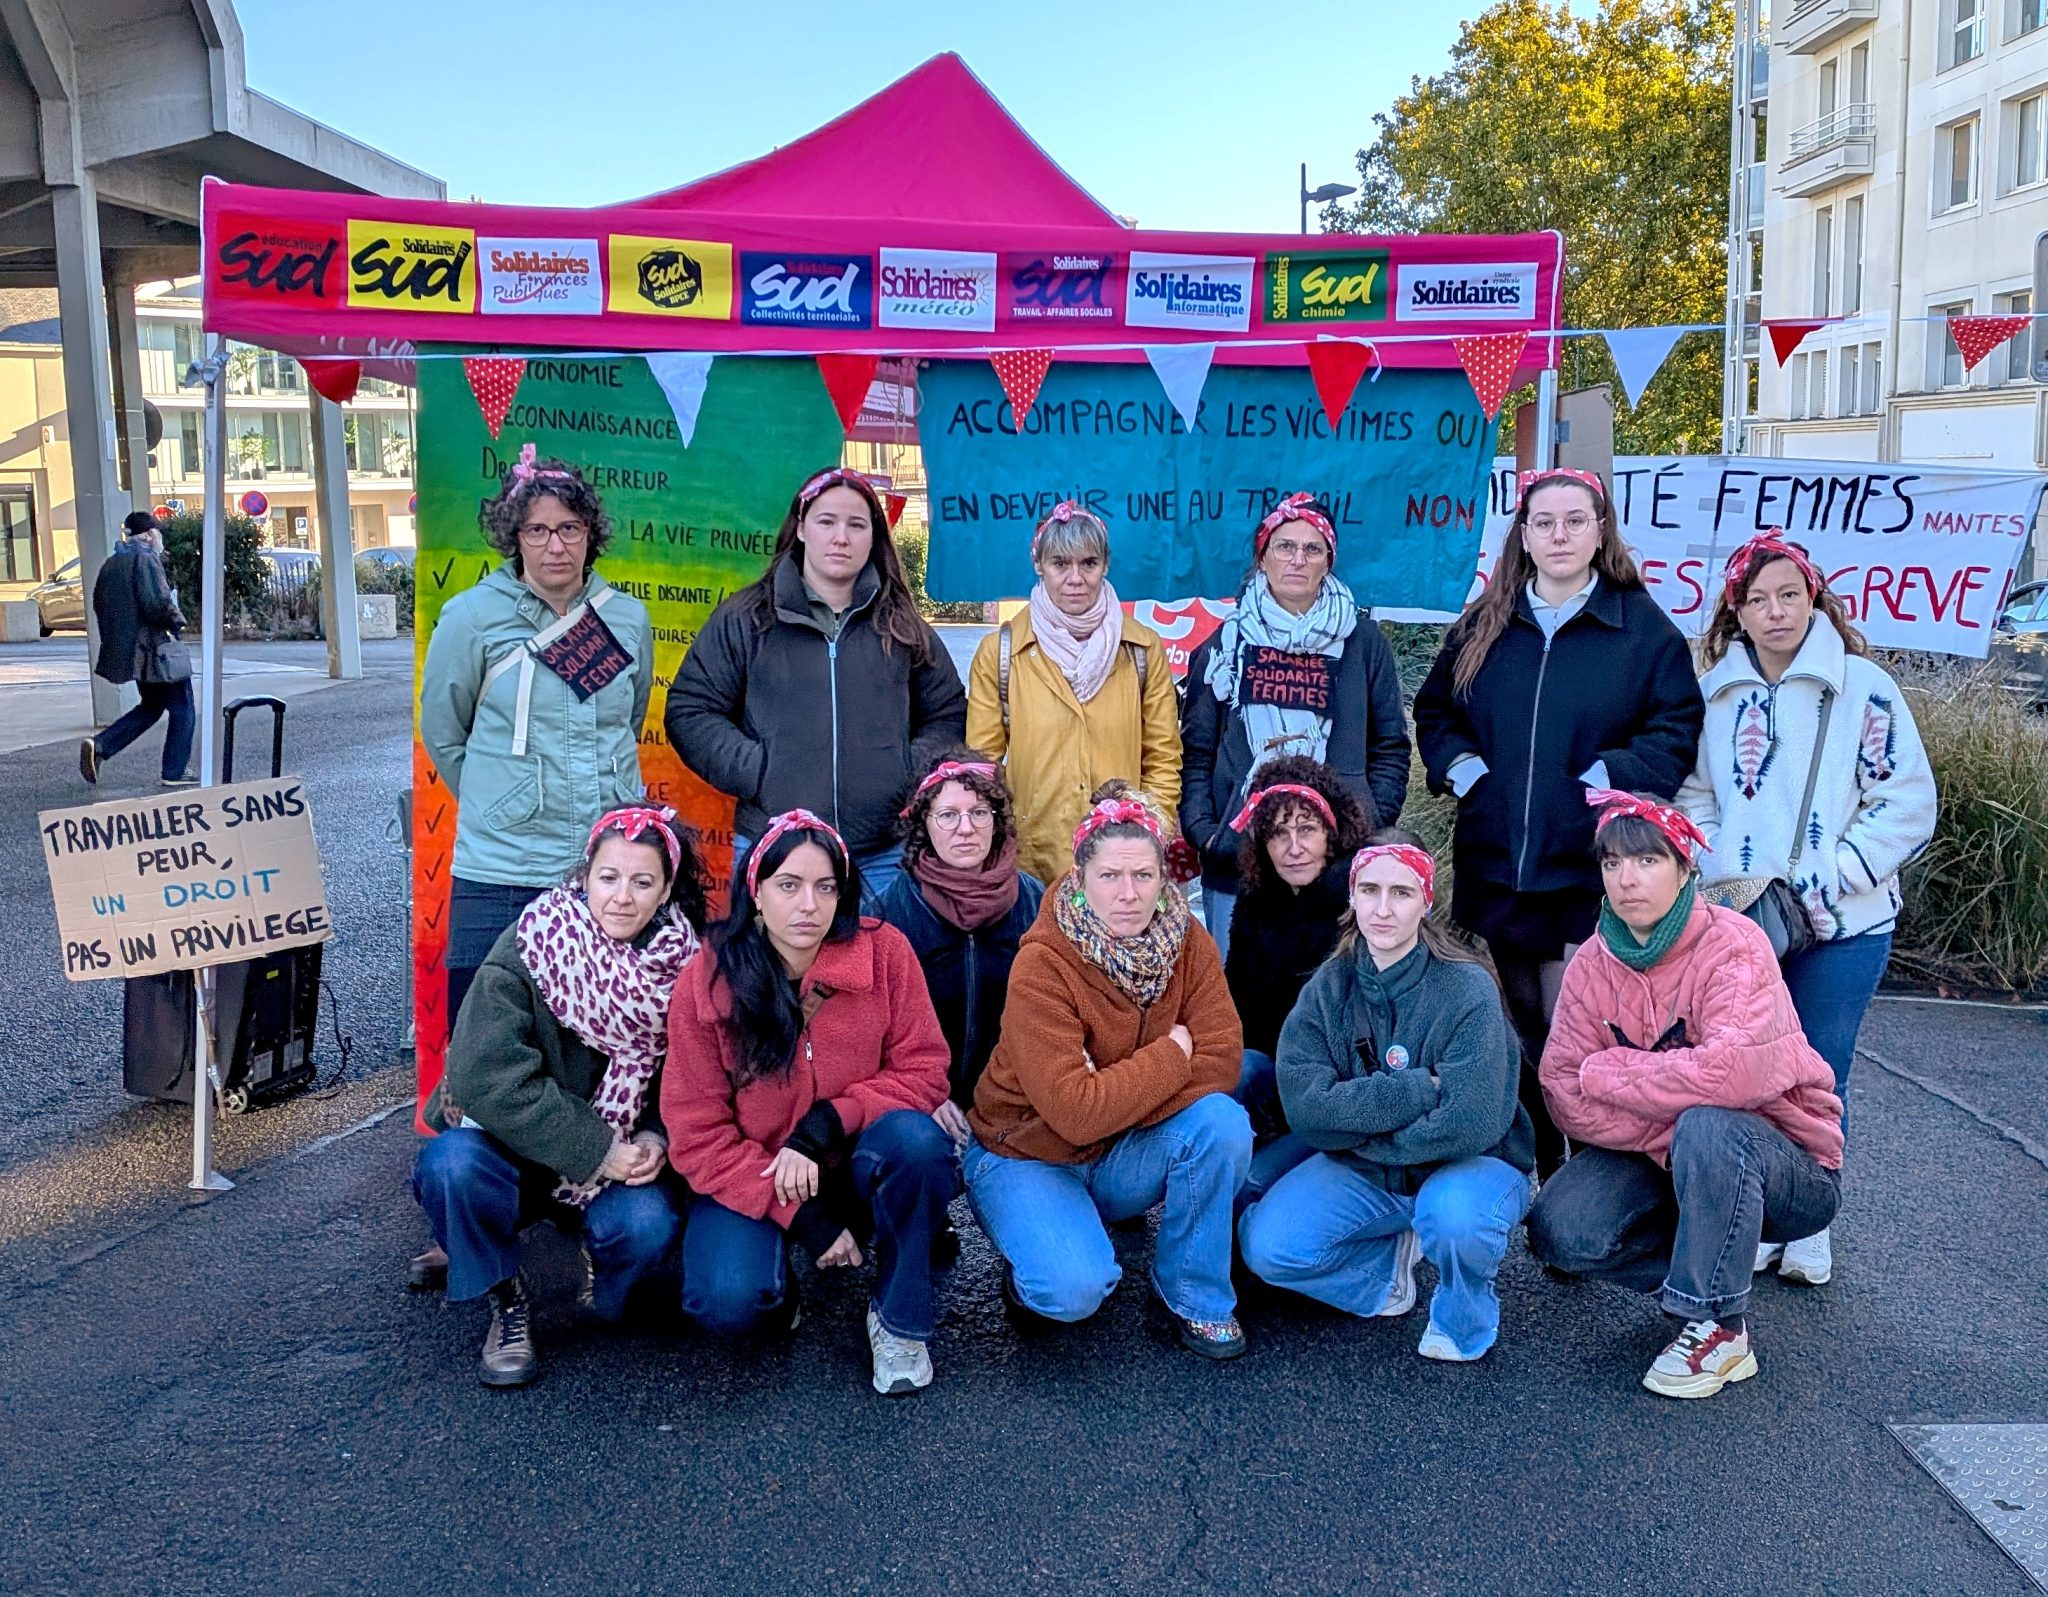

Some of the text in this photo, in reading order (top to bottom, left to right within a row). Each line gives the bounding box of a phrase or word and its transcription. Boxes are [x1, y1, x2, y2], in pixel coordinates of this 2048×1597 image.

[402, 237, 457, 257] Solidaires
[490, 250, 590, 274] Solidaires
[1053, 255, 1100, 270] Solidaires
[219, 231, 339, 298] Sud
[351, 238, 472, 303] Sud
[518, 273, 588, 287] Finances
[646, 254, 689, 288] Sud
[492, 283, 570, 303] Publiques
[653, 278, 697, 302] Solidaires
[750, 262, 860, 313] Sud
[881, 265, 977, 301] Solidaires
[1012, 255, 1113, 309] Sud
[1134, 271, 1242, 304] Solidaires
[1272, 256, 1290, 319] Solidaires
[1300, 262, 1380, 305] Sud
[1411, 279, 1521, 305] Solidaires
[750, 308, 862, 323] Collectivités territoriales
[892, 300, 975, 316] météo
[1012, 307, 1042, 317] TRAVAIL
[1046, 307, 1079, 317] AFFAIRES
[1080, 307, 1113, 317] SOCIALES
[1301, 305, 1346, 318] chimie
[1225, 402, 1278, 437] LES
[1437, 410, 1488, 448] OUI
[941, 493, 980, 522] EN
[1127, 490, 1177, 521] UNE
[1188, 489, 1224, 524] AU
[1405, 493, 1477, 532] NON
[1714, 470, 1921, 534] FEMMES
[1922, 510, 2026, 537] NANTES
[630, 519, 655, 543] LA
[710, 529, 776, 556] PRIVÉE
[658, 584, 712, 604] DISTANTE
[1257, 649, 1327, 668] SALARIÉE
[1247, 665, 1330, 687] SOLIDARITÉ
[1252, 680, 1329, 709] FEMMES
[44, 785, 305, 857] TRAVAILLER SANS
[92, 868, 280, 916] UN DROIT
[66, 939, 111, 973] PAS
[119, 932, 157, 966] UN
